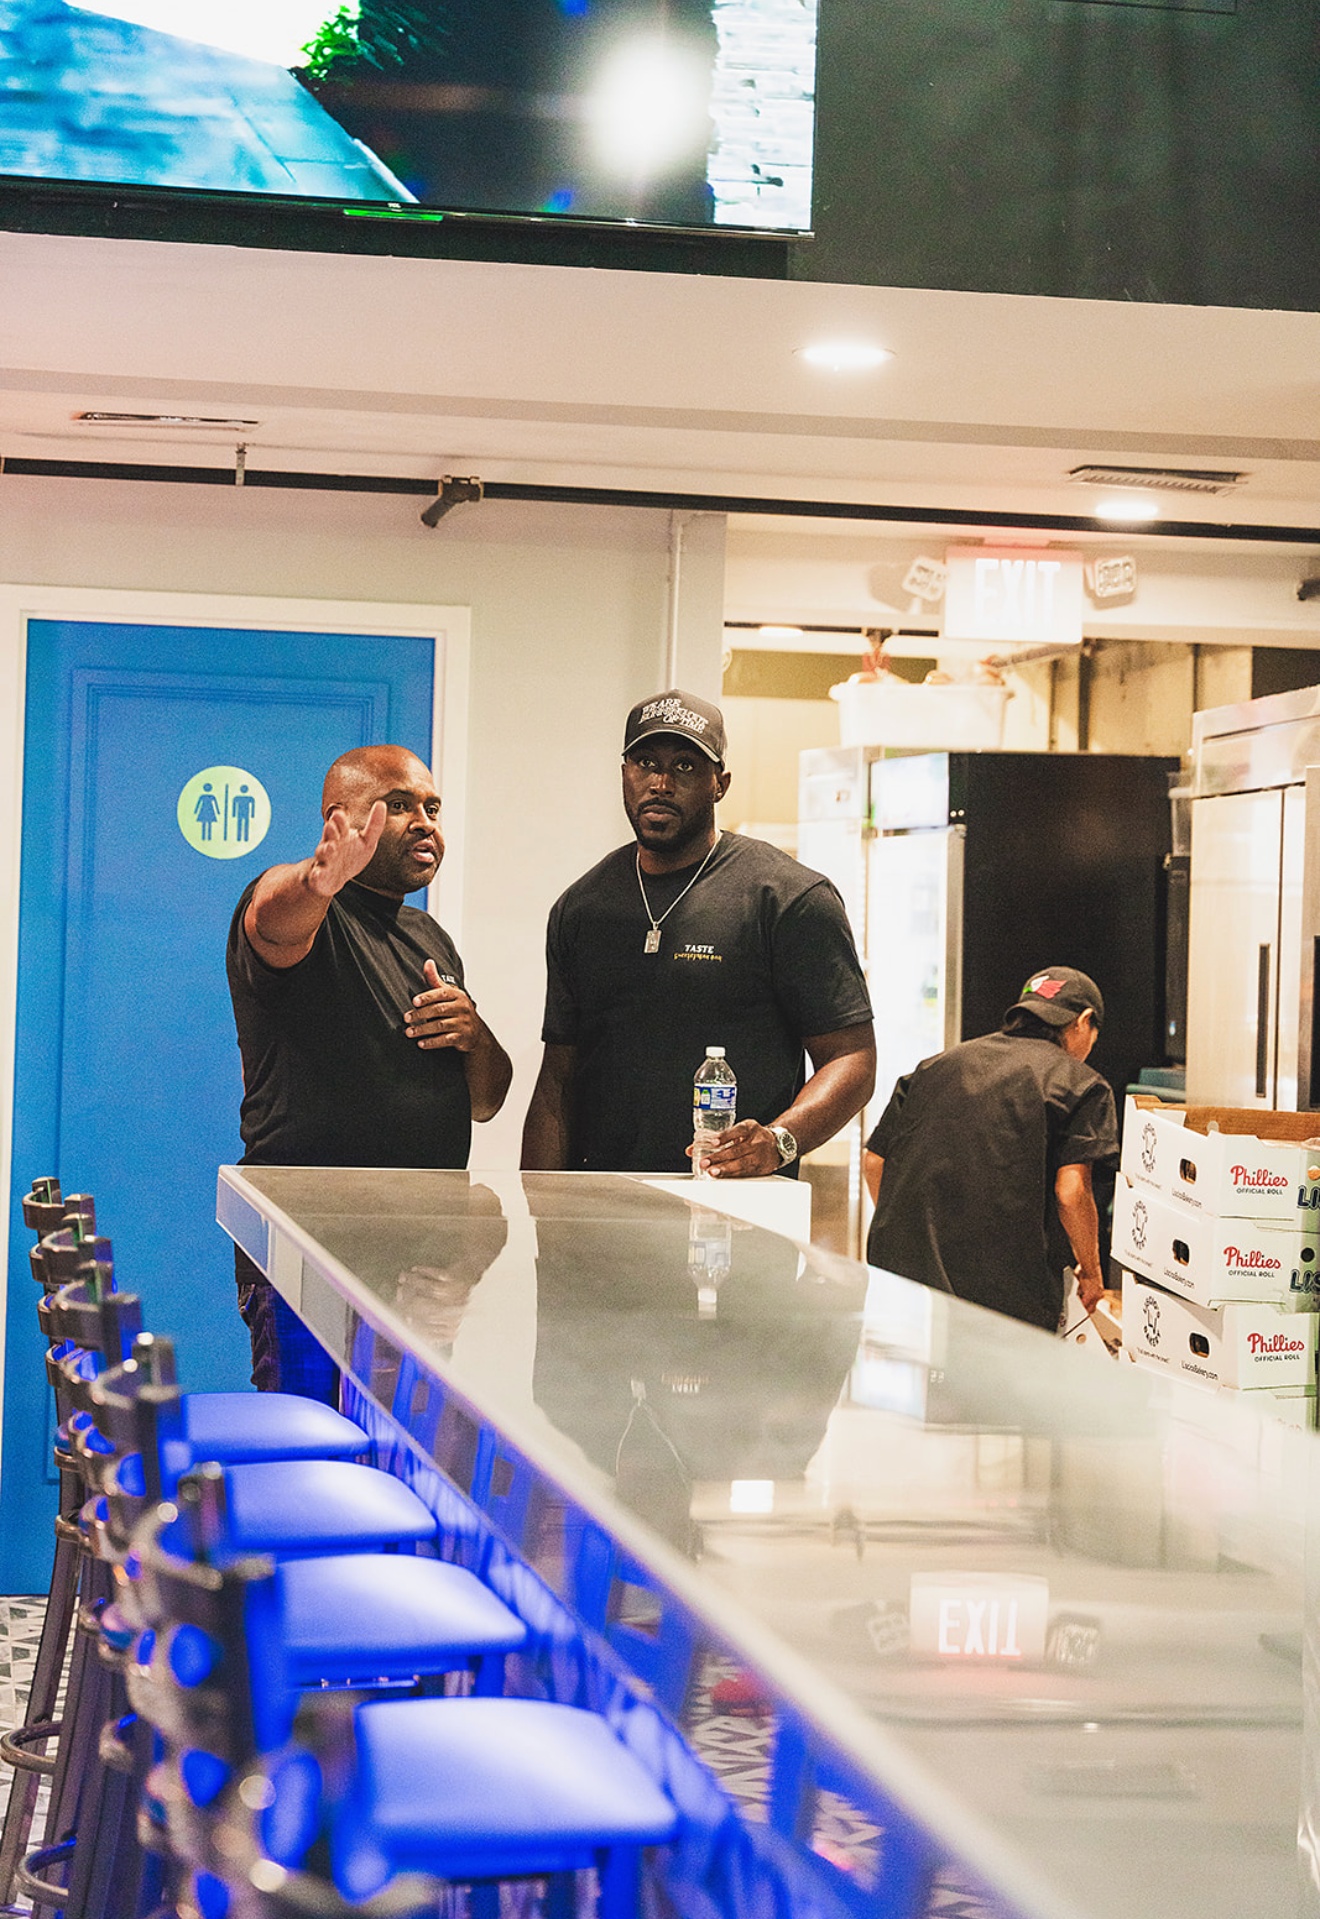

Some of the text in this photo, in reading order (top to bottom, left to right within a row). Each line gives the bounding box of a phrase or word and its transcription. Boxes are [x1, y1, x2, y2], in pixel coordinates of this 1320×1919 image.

[975, 559, 1061, 629] EXIT
[685, 944, 714, 954] TASTE
[1230, 1165, 1289, 1187] Phillies
[1236, 1187, 1265, 1195] OFFICIAL
[1223, 1246, 1281, 1269] Phillies
[1228, 1269, 1257, 1277] OFFICIAL
[1247, 1332, 1305, 1354] Phillies
[1254, 1353, 1300, 1363] OFFICIAL ROLL
